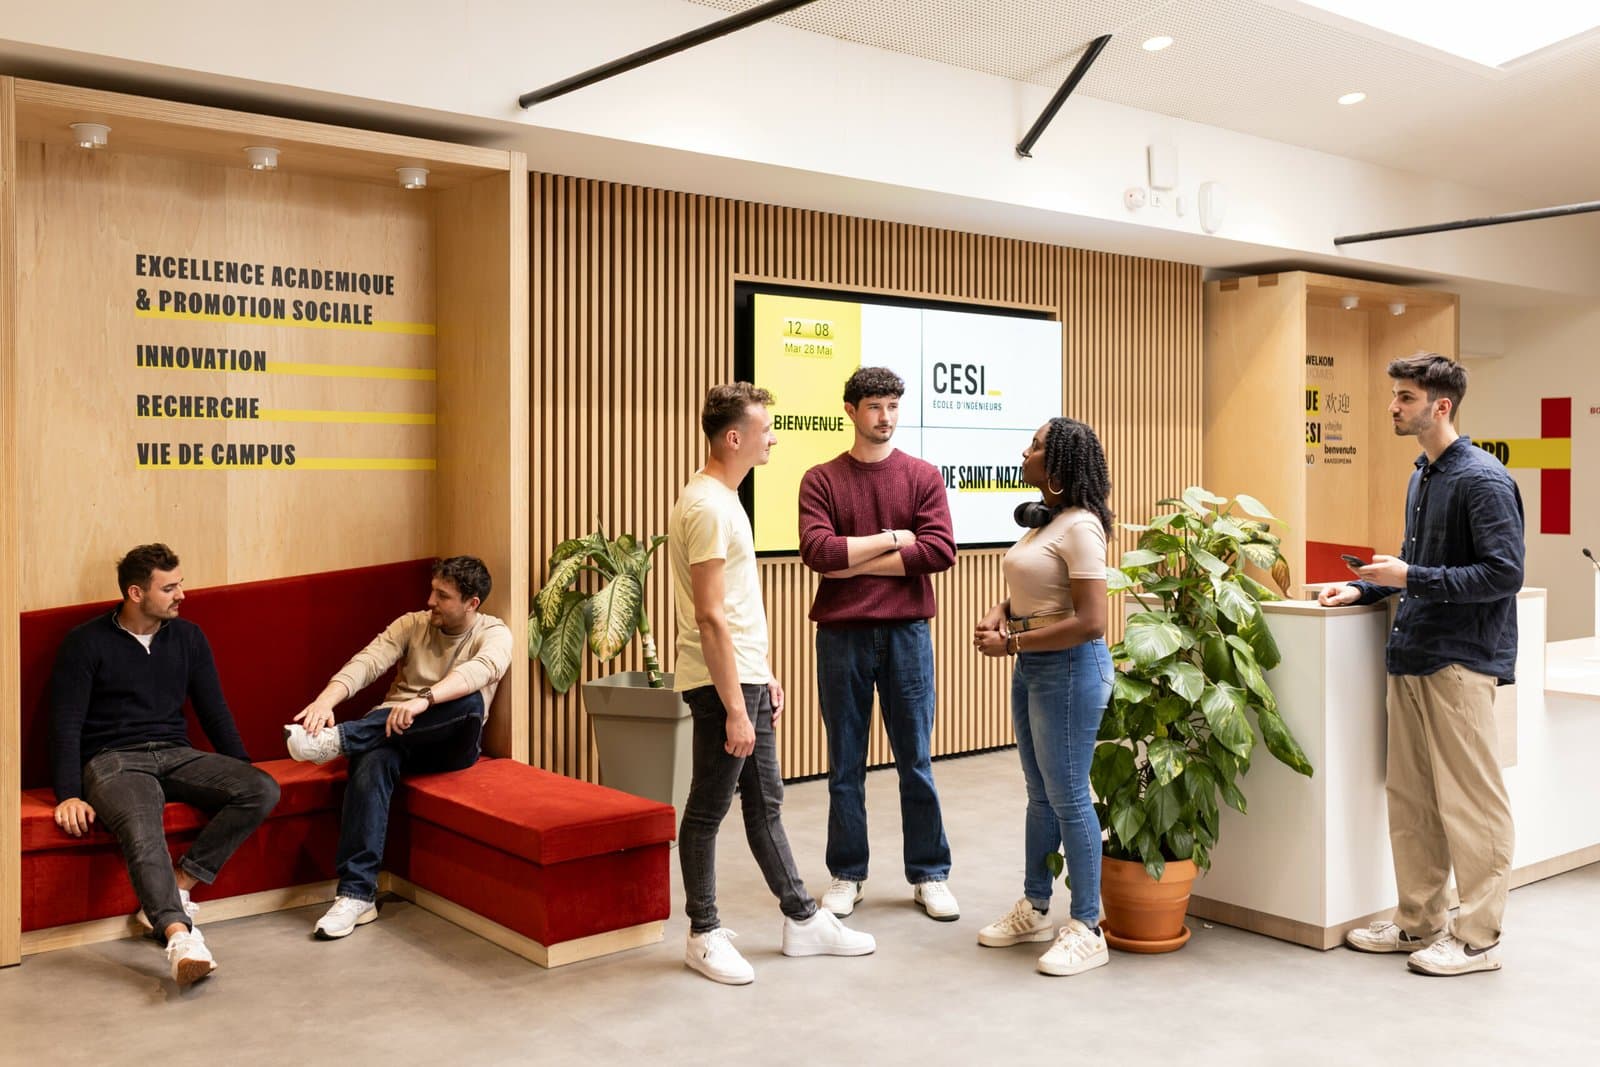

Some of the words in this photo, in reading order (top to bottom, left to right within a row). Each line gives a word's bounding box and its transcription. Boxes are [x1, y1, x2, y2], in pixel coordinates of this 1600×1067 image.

[135, 254, 265, 285] EXCELLENCE
[271, 266, 395, 296] ACADEMIQUE
[135, 289, 151, 311] &
[159, 290, 286, 320] PROMOTION
[292, 300, 374, 325] SOCIALE
[788, 320, 802, 335] 12
[814, 323, 829, 336] 08
[136, 344, 267, 372] INNOVATION
[785, 343, 801, 353] Mar
[804, 344, 815, 354] 28
[1306, 355, 1334, 367] WELKOM
[933, 362, 985, 395] CESI
[136, 395, 260, 419] RECHERCHE
[1325, 392, 1351, 414] 欢迎
[774, 415, 844, 432] BIENVENUE
[136, 443, 171, 465] VIE
[178, 443, 204, 465] DE
[211, 443, 296, 466] CAMPUS
[1324, 444, 1357, 455] benvenuto
[941, 465, 956, 489] DE
[958, 465, 1036, 489] SAINT-NAZA
